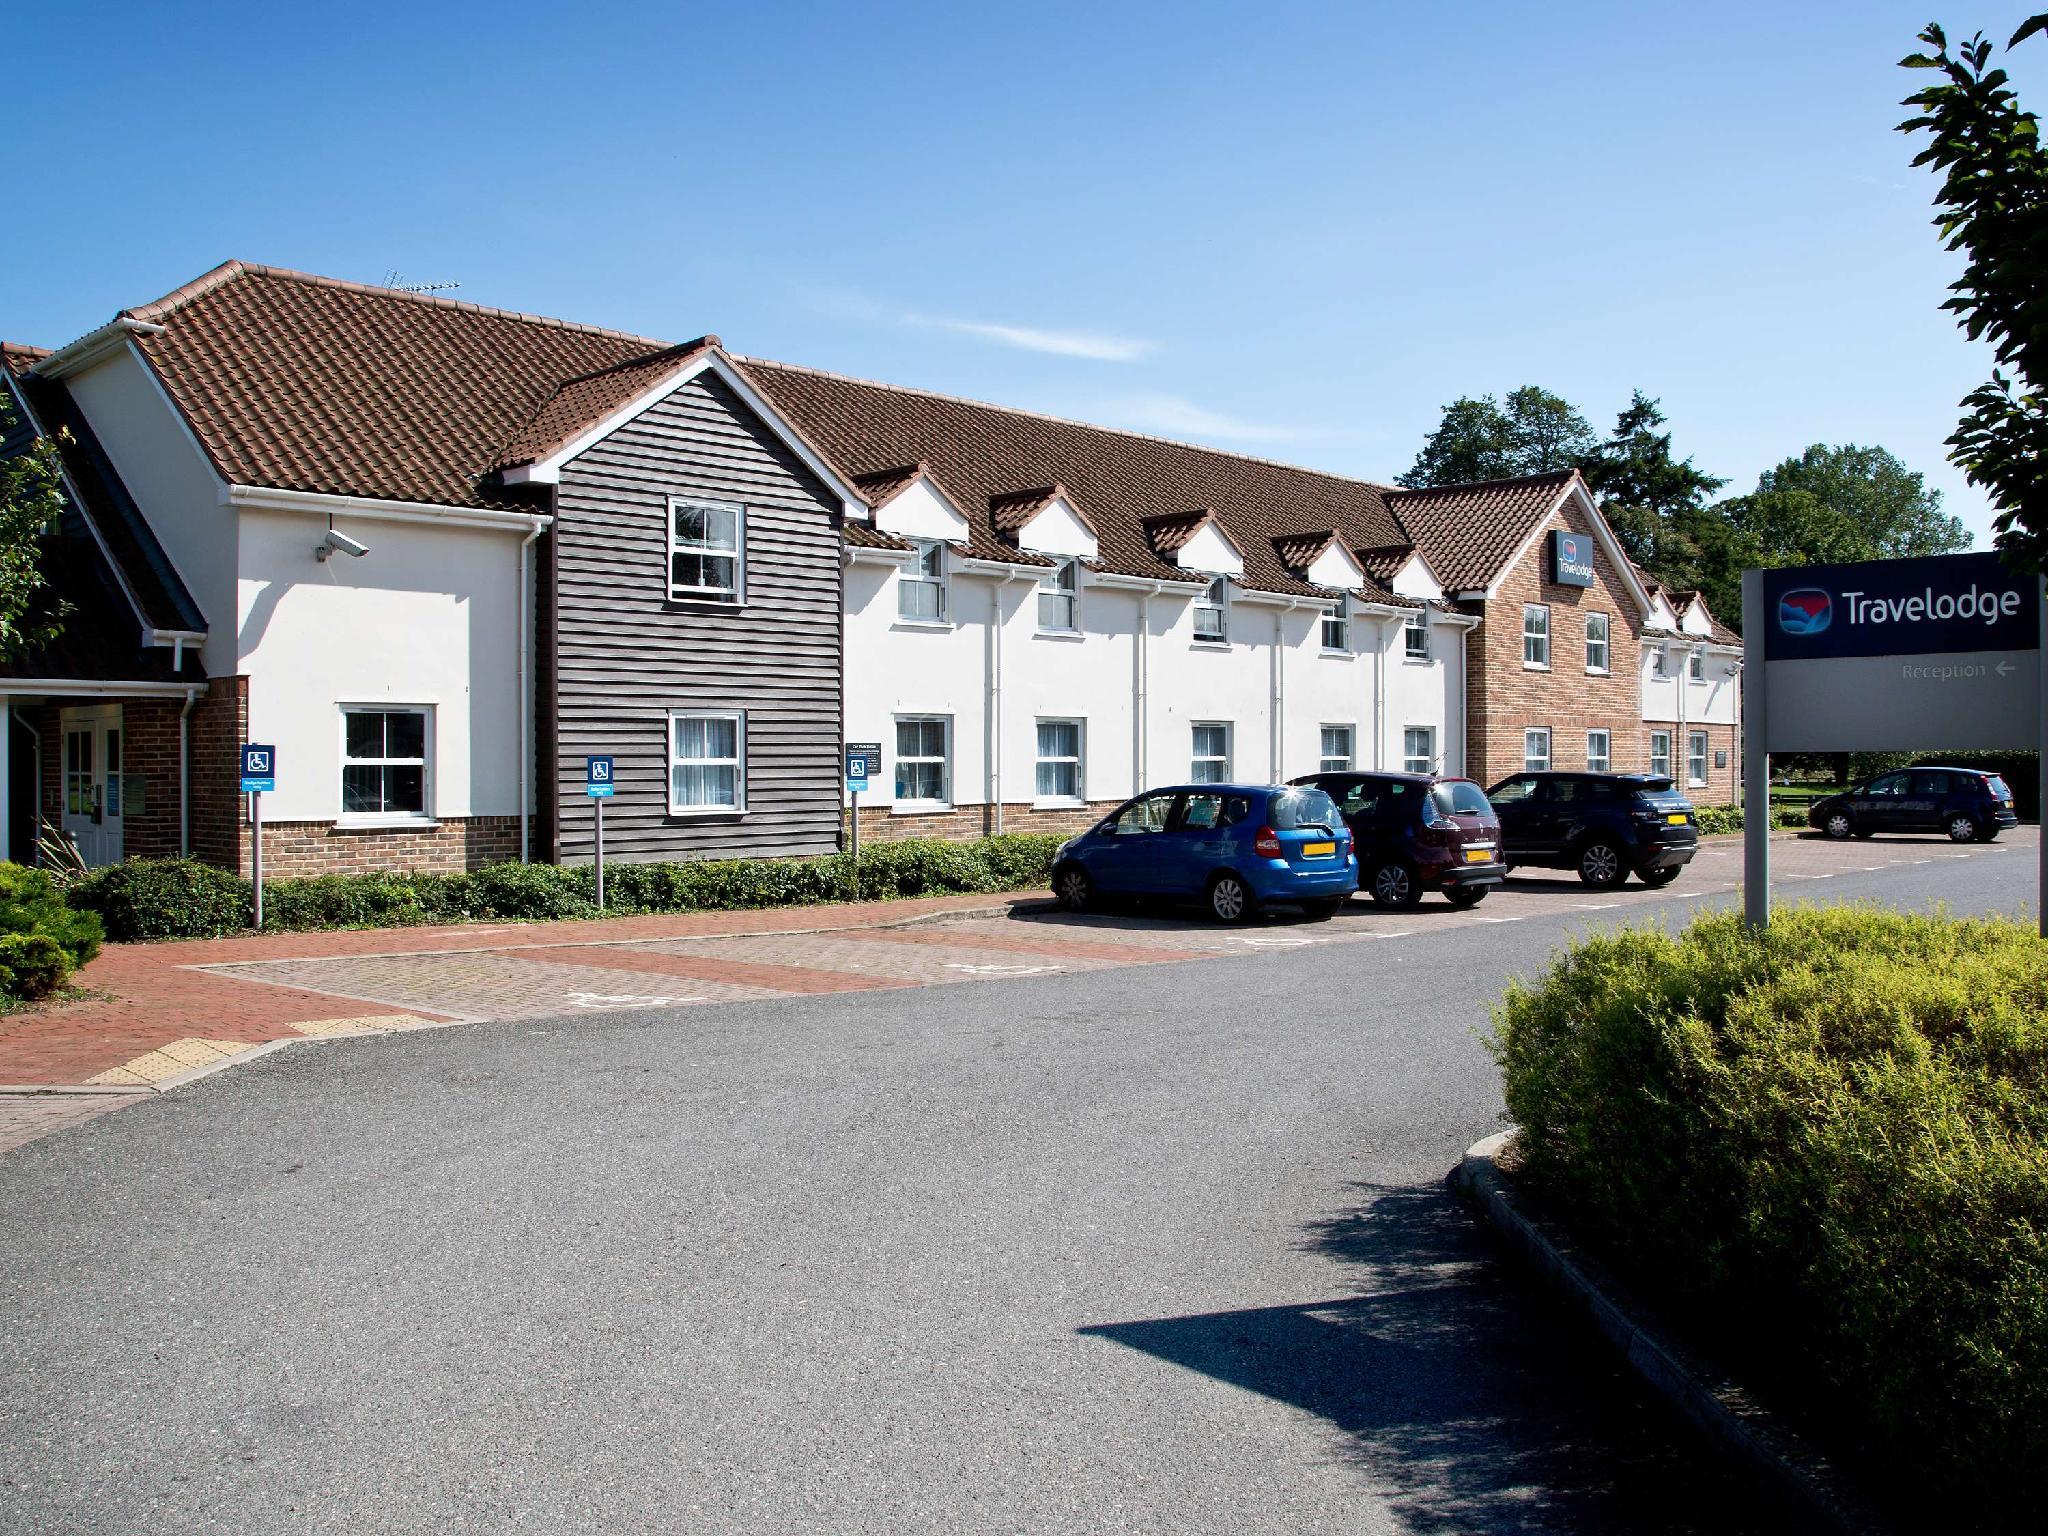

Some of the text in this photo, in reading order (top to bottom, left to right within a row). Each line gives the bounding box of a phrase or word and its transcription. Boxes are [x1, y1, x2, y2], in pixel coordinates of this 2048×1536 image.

[1559, 558, 1592, 579] Travelodge
[1841, 584, 2021, 625] Travelodge
[1903, 664, 1986, 682] Reception
